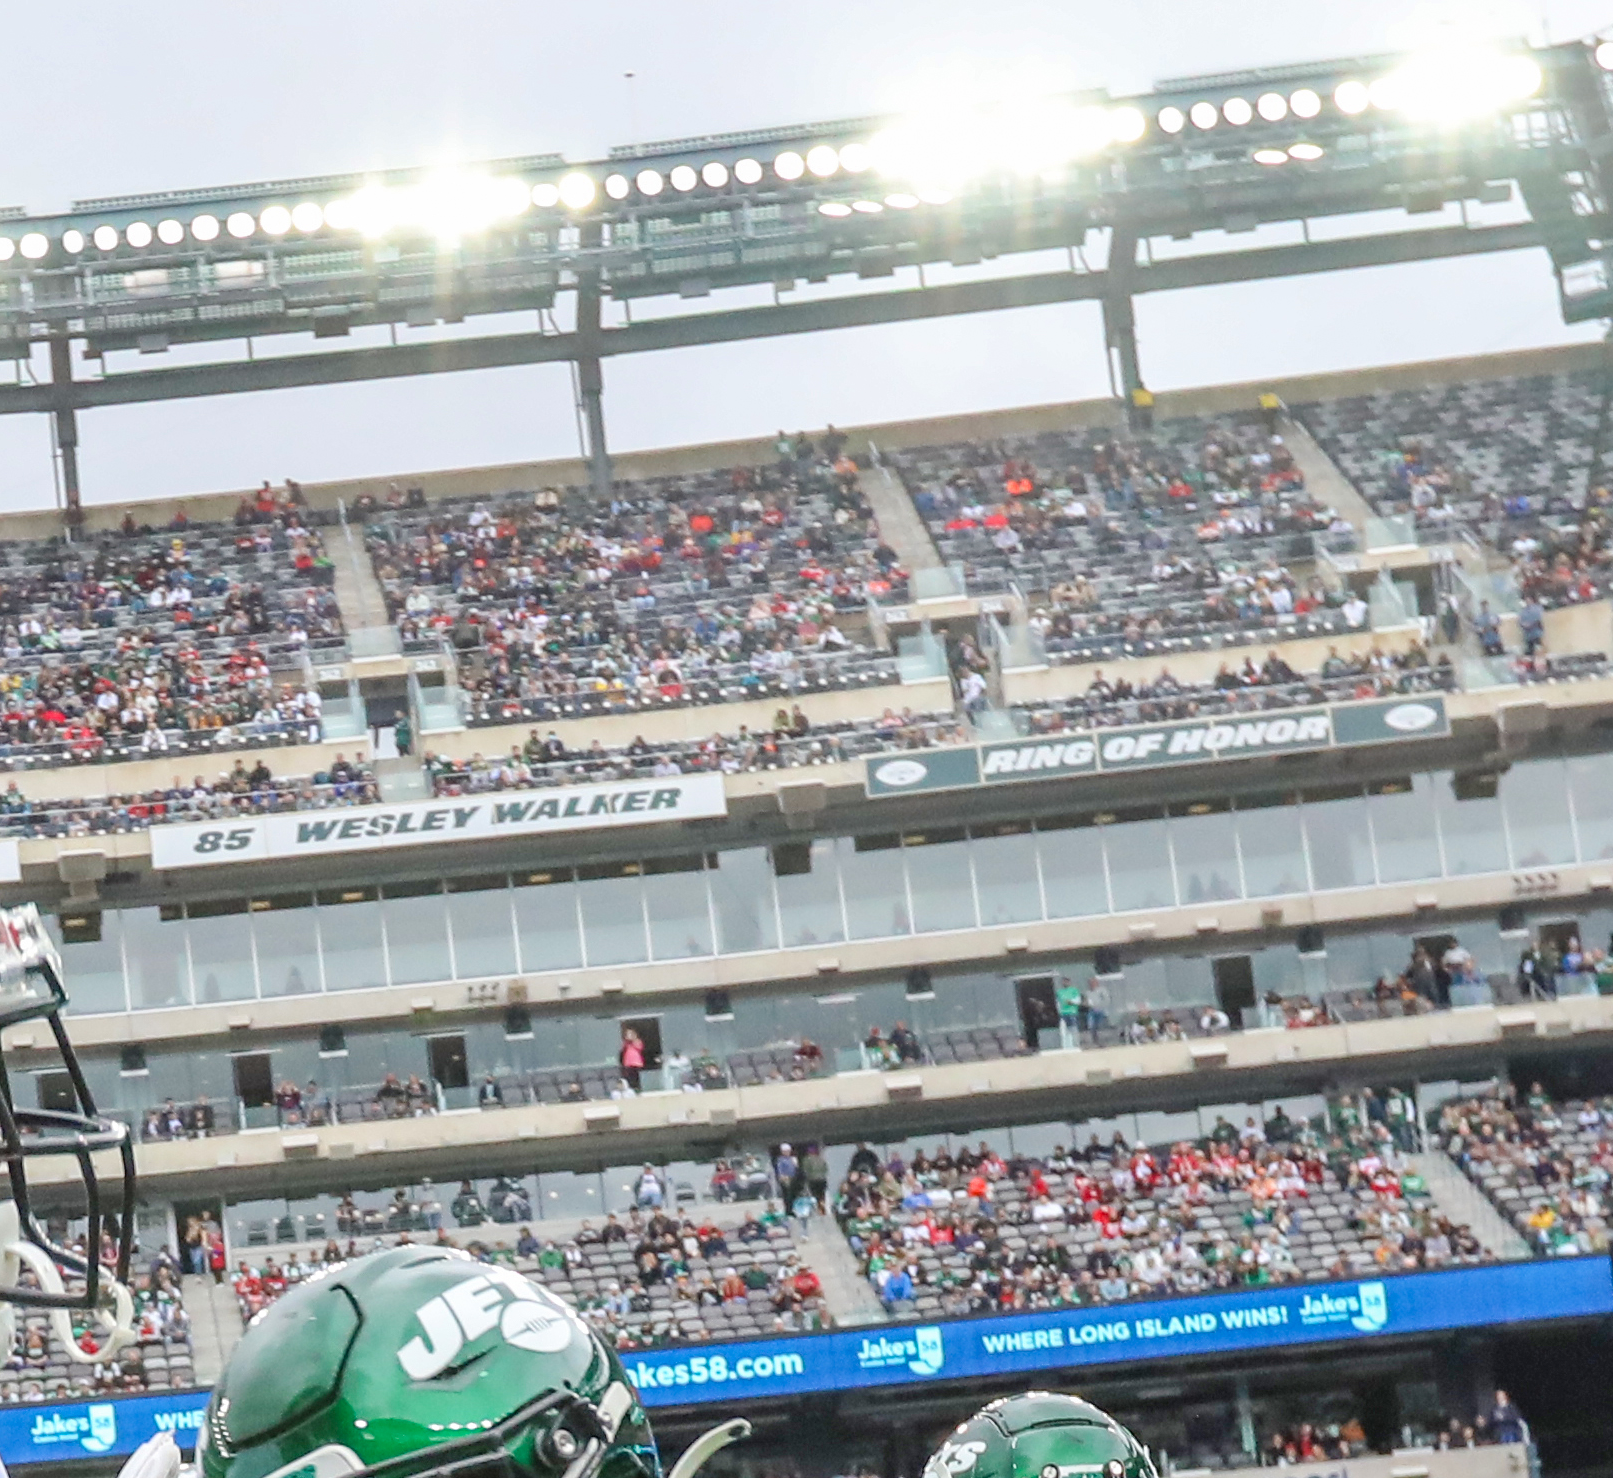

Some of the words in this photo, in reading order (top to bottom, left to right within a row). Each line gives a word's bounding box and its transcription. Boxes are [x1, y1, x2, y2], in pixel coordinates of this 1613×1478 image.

[983, 741, 1095, 775] RING
[1102, 733, 1173, 764] OF
[1173, 713, 1332, 753] HONOR
[193, 827, 256, 854] 85
[296, 806, 481, 844] WESLEY
[491, 786, 683, 825] WALKER
[397, 1267, 570, 1382] JET
[983, 1332, 1065, 1354] WHERE
[1069, 1325, 1131, 1347] LONG
[1136, 1313, 1217, 1339] ISLAND
[1222, 1305, 1289, 1328] WINS!
[624, 1352, 804, 1390] akes58.com
[31, 1413, 90, 1436] Jake's
[154, 1410, 205, 1432] WHE
